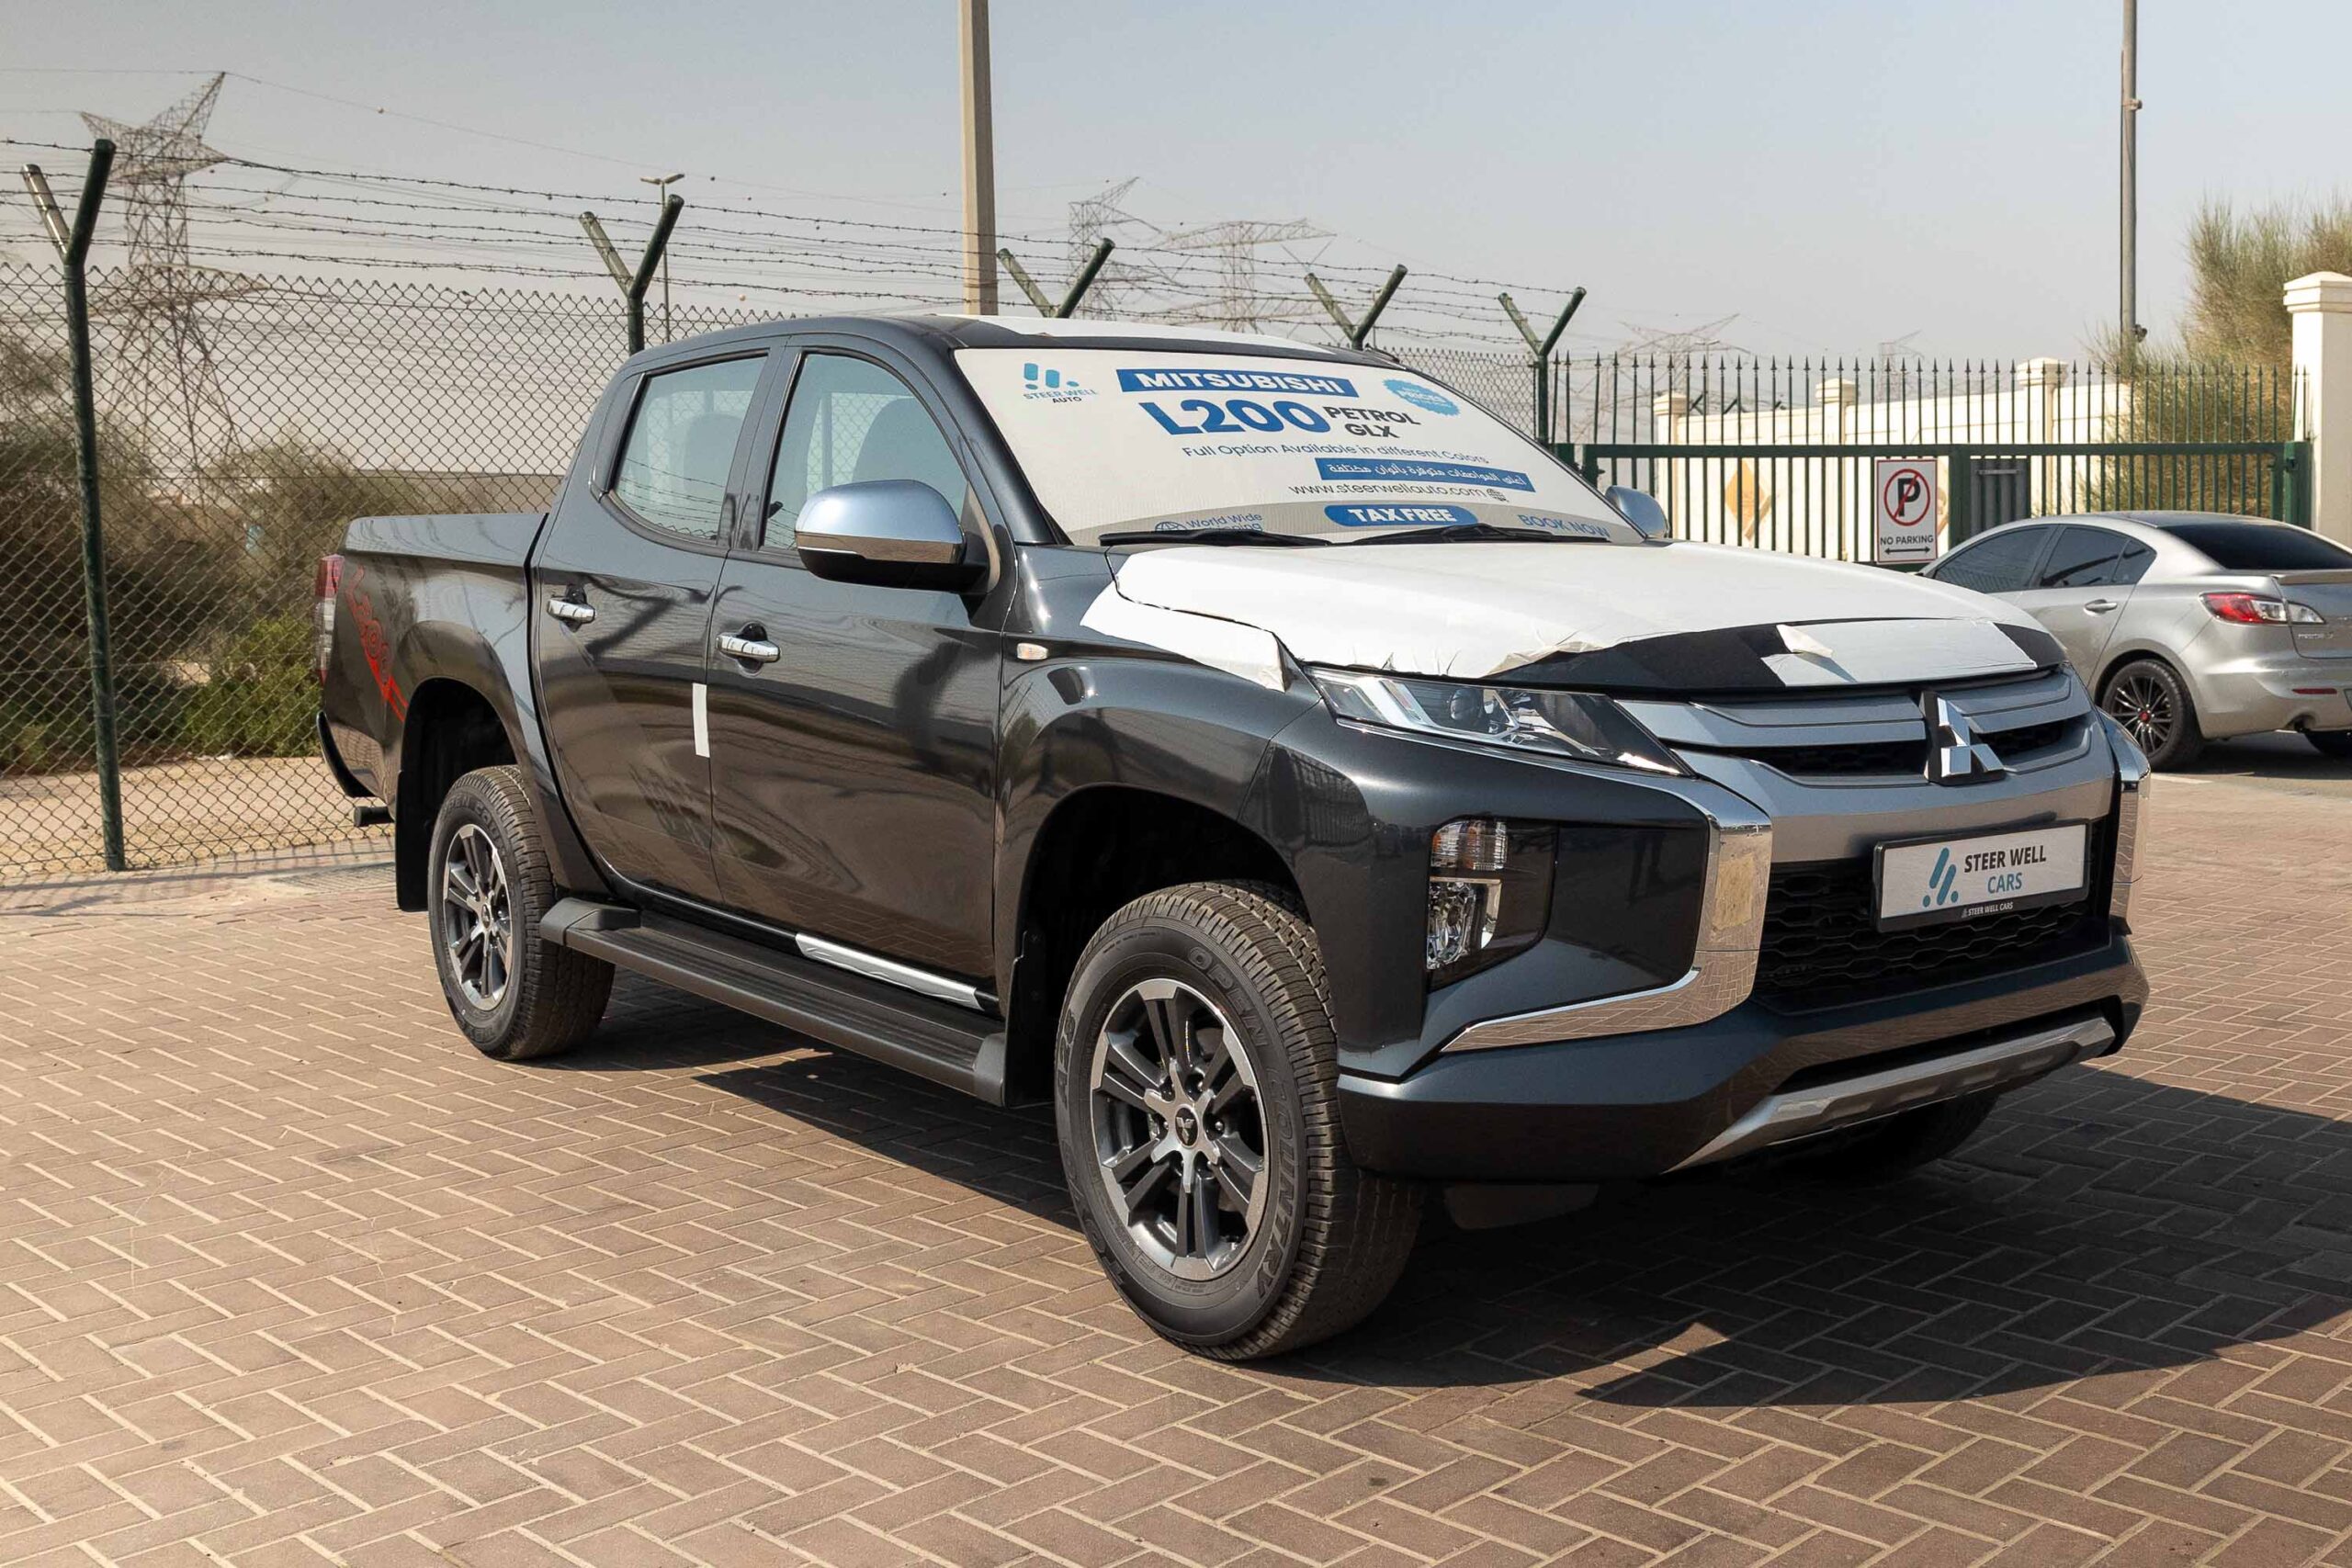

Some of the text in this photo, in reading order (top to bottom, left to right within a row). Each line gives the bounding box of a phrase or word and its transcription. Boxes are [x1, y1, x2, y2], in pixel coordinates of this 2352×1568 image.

[1134, 372, 1345, 394] MITSUBISHI
[1023, 389, 1099, 400] STEER WELL
[1138, 398, 1331, 436] L200
[1322, 406, 1421, 426] PETROL
[1344, 422, 1400, 439] GLX
[1182, 445, 1216, 457] Full
[1221, 443, 1278, 458] Option
[1282, 443, 1356, 455] Available
[1357, 444, 1375, 456] in
[1376, 445, 1440, 457] different
[1326, 463, 1373, 473] مختلفة
[1408, 465, 1446, 477] متوفرة
[1447, 468, 1501, 482] المواصفات
[1288, 482, 1487, 497] www.steerwellauto.com
[1897, 477, 1921, 517] P
[1186, 513, 1263, 529] World Wide
[1348, 507, 1458, 523] TAX FREE
[1518, 513, 1611, 538] BOOK NOW
[1880, 535, 1934, 546] NO PARKING
[1963, 844, 2047, 874] STEER WELL
[1987, 872, 2023, 895] CARS
[1968, 901, 2014, 917] STEER WELL CARS
[1188, 946, 1295, 1300] OPEN COUNTRY
